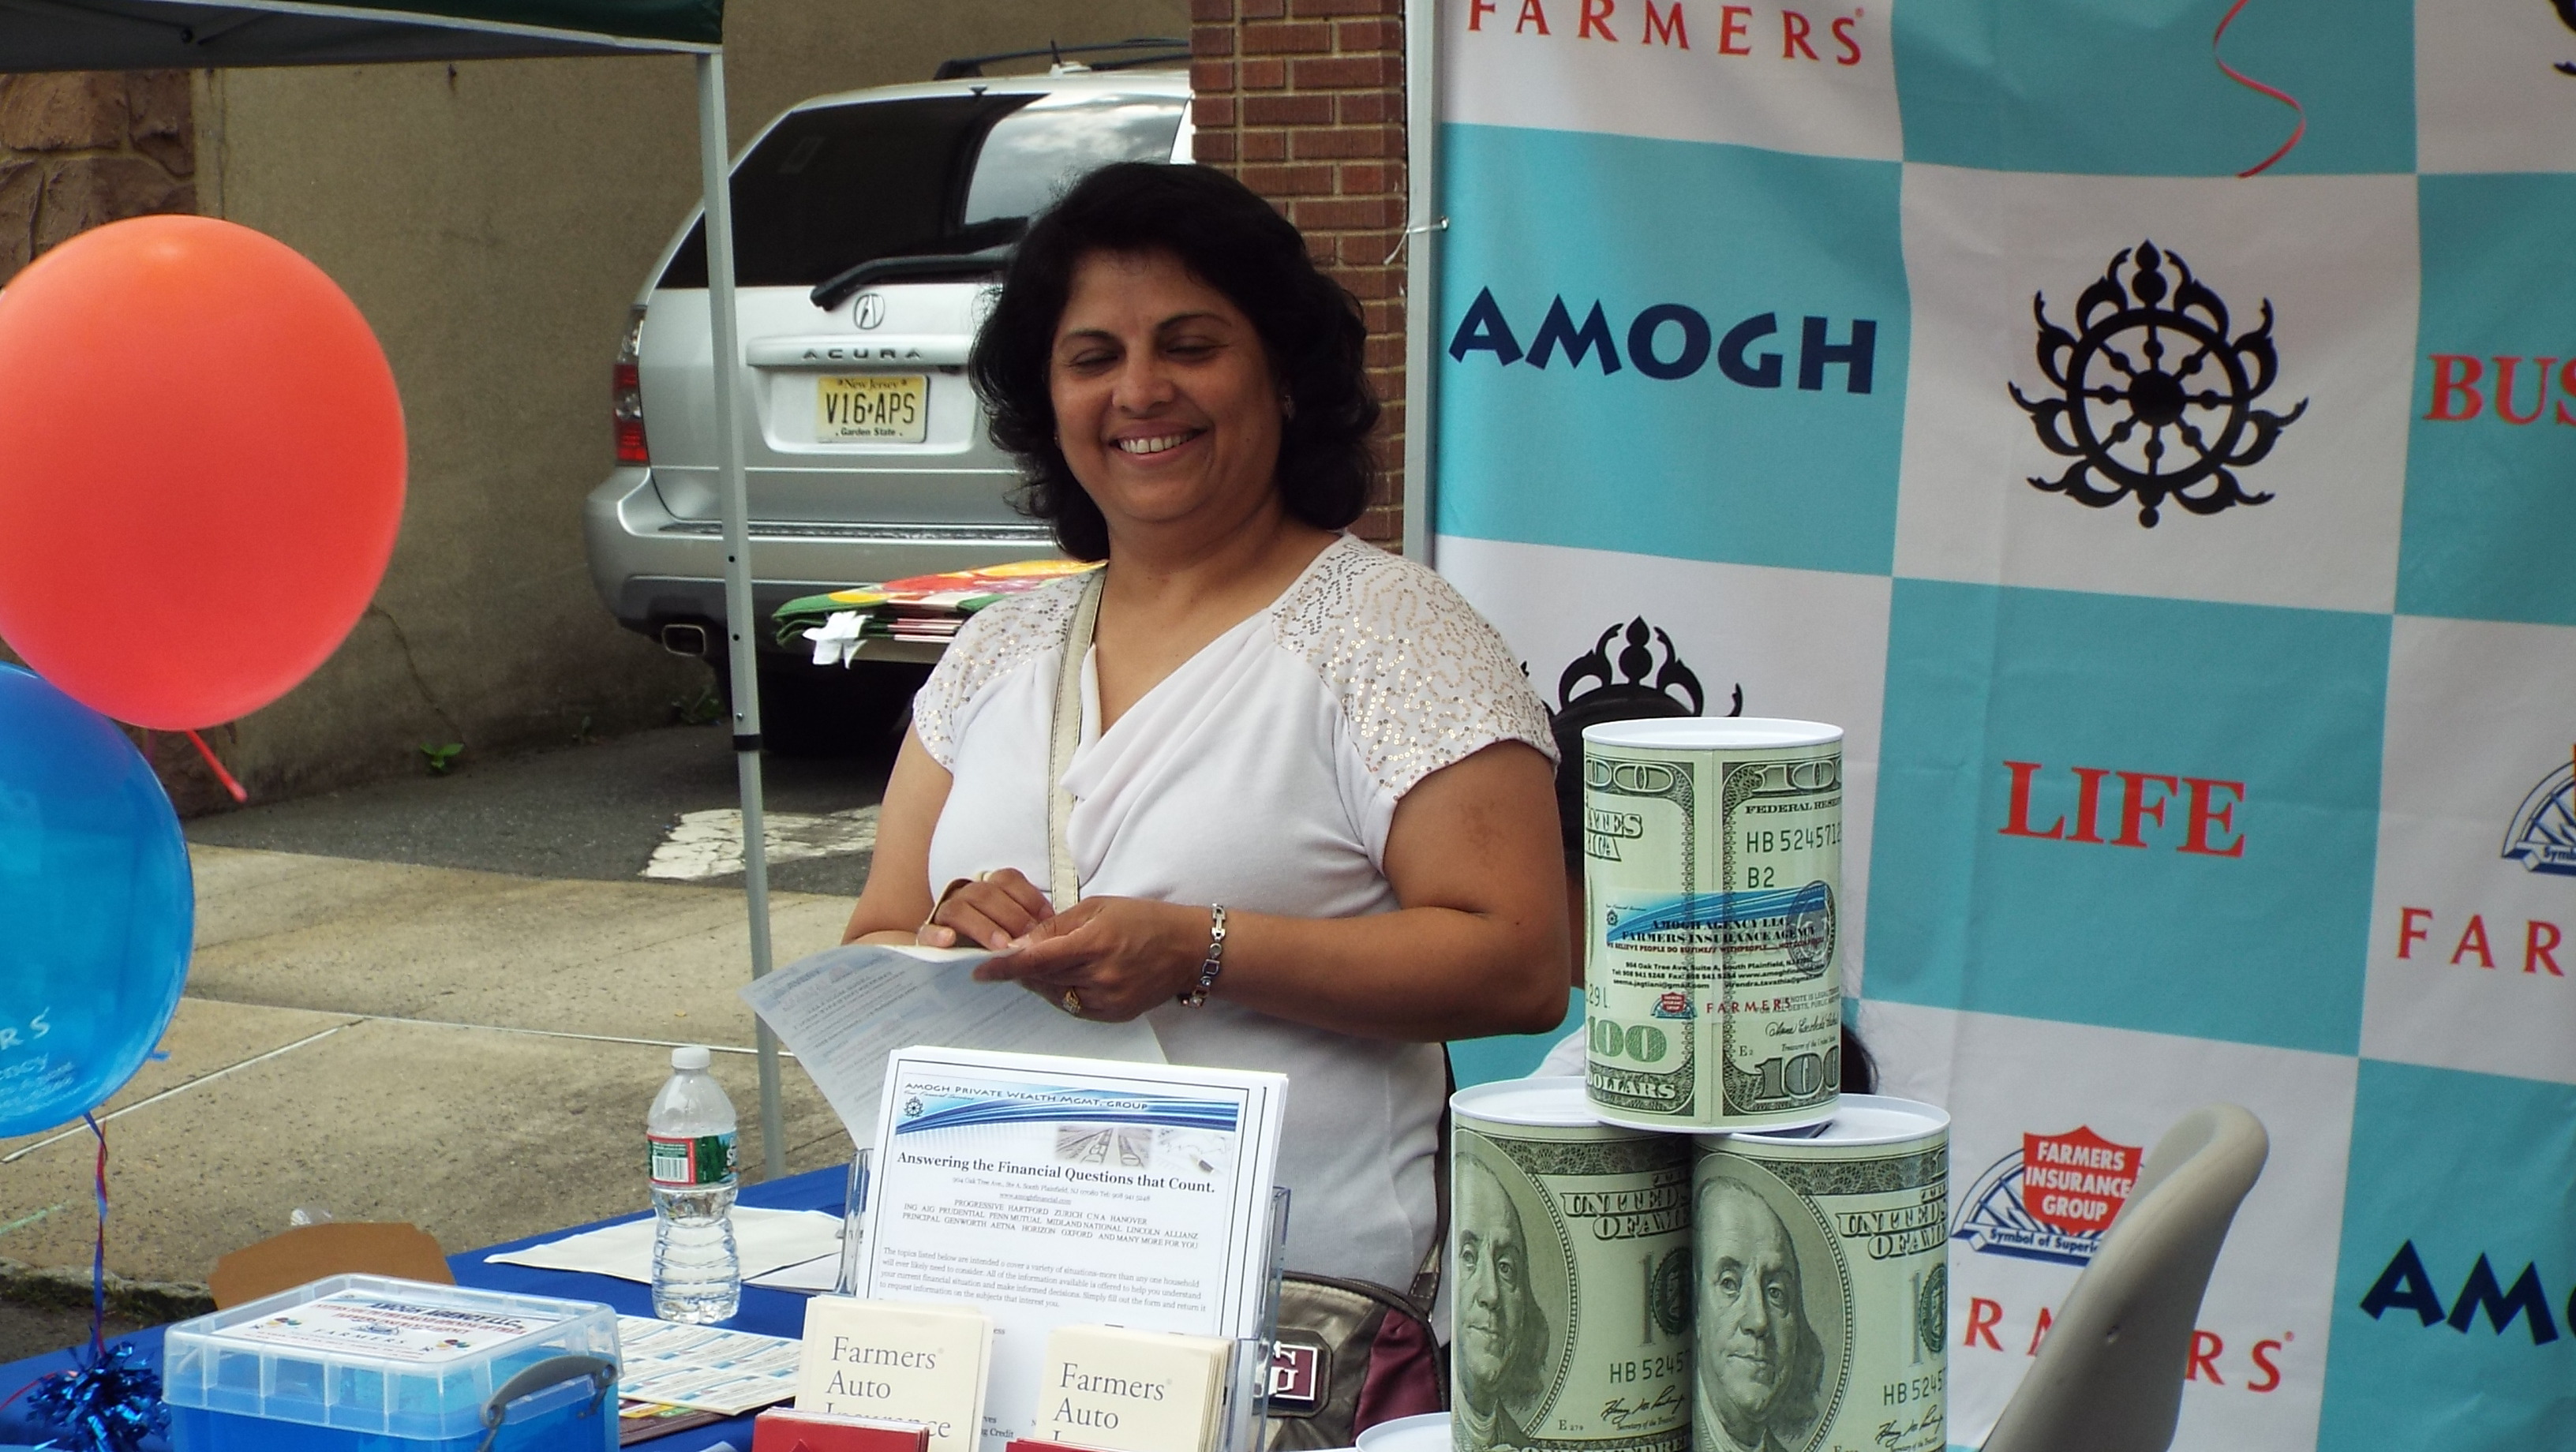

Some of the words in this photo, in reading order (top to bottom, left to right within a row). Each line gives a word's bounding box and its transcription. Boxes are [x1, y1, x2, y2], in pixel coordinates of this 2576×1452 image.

[803, 349, 922, 359] ACURA
[1449, 286, 1877, 395] AMOGH
[844, 378, 867, 388] New
[869, 379, 897, 390] Jersey
[841, 427, 870, 436] Garden
[874, 427, 896, 436] State
[1745, 803, 1812, 814] FEDERAL
[1998, 760, 2246, 858] LIFE
[1747, 831, 1773, 853] HB
[1748, 866, 1774, 889] B2
[1622, 931, 1685, 943] FARMERS
[1689, 931, 1771, 944] INSURANCE
[2397, 908, 2565, 976] FAR
[1706, 997, 1791, 1014] FARMERS
[904, 1082, 949, 1091] AMOGH
[955, 1087, 1002, 1096] PRIVATE
[1007, 1091, 1055, 1101] WEALTH
[1106, 1099, 1148, 1108] GROUP
[2037, 1141, 2125, 1171] FARMERS
[897, 1151, 969, 1171] Answering
[972, 1158, 994, 1171] the
[998, 1161, 1060, 1177] Financial
[1065, 1167, 1133, 1187] Questions
[1137, 1174, 1163, 1188] that
[1169, 1177, 1215, 1193] Count.
[2024, 1166, 2132, 1198] INSURANCE
[939, 1207, 984, 1218] PRUDENTIAL
[1009, 1214, 1041, 1223] MUTUAL
[1126, 1226, 1159, 1235] LINCOLN
[1164, 1229, 1198, 1240] ALLIANZ
[954, 1199, 1003, 1211] PROGRESSIVE
[1008, 1204, 1048, 1215] HARTFORD
[1054, 1209, 1083, 1218] ZURICH
[1110, 1214, 1148, 1224] HANOVER
[1835, 1202, 1939, 1237] UNITED
[2042, 1196, 2108, 1222] GROUP
[903, 1212, 940, 1222] PRINCIPAL
[945, 1216, 987, 1227] GENWORTH
[990, 1221, 1015, 1229] AETNA
[1022, 1224, 1055, 1233] HORIZON
[1061, 1229, 1092, 1238] OXFORD
[1099, 1232, 1115, 1241] AND
[1116, 1234, 1140, 1243] MANY
[1141, 1237, 1163, 1245] MORE
[1990, 1229, 2034, 1245] Symbol
[2039, 1236, 2050, 1247] of
[897, 1249, 915, 1259] topics
[918, 1250, 935, 1259] listed
[938, 1252, 955, 1261] below
[969, 1256, 998, 1266] intended
[1031, 1263, 1053, 1273] variety
[1163, 1275, 1199, 1286] household
[910, 1261, 927, 1271] likely
[1017, 1272, 1057, 1284] information
[1058, 1277, 1088, 1287] available
[1096, 1281, 1121, 1290] offered
[1131, 1284, 1146, 1295] help
[1162, 1287, 1200, 1299] understand
[888, 1282, 911, 1293] request
[913, 1285, 952, 1296] information
[975, 1292, 1002, 1304] subjects
[1004, 1294, 1017, 1303] that
[1019, 1296, 1043, 1306] interest
[923, 1274, 950, 1283] financial
[952, 1277, 980, 1287] situation
[983, 1280, 995, 1289] and
[997, 1282, 1015, 1290] make
[1016, 1284, 1046, 1294] informed
[1082, 1291, 1105, 1303] Simply
[1107, 1293, 1116, 1302] fill
[1144, 1297, 1160, 1307] form
[1162, 1300, 1175, 1308] and
[1177, 1302, 1199, 1311] return
[2359, 1239, 2576, 1345] AM
[831, 1336, 937, 1369] Farmers
[826, 1369, 891, 1398] Auto
[1060, 1362, 1165, 1401] Farmers
[1610, 1362, 1637, 1383] HB
[1884, 1383, 1907, 1406] HB
[1053, 1397, 1119, 1429] Auto
